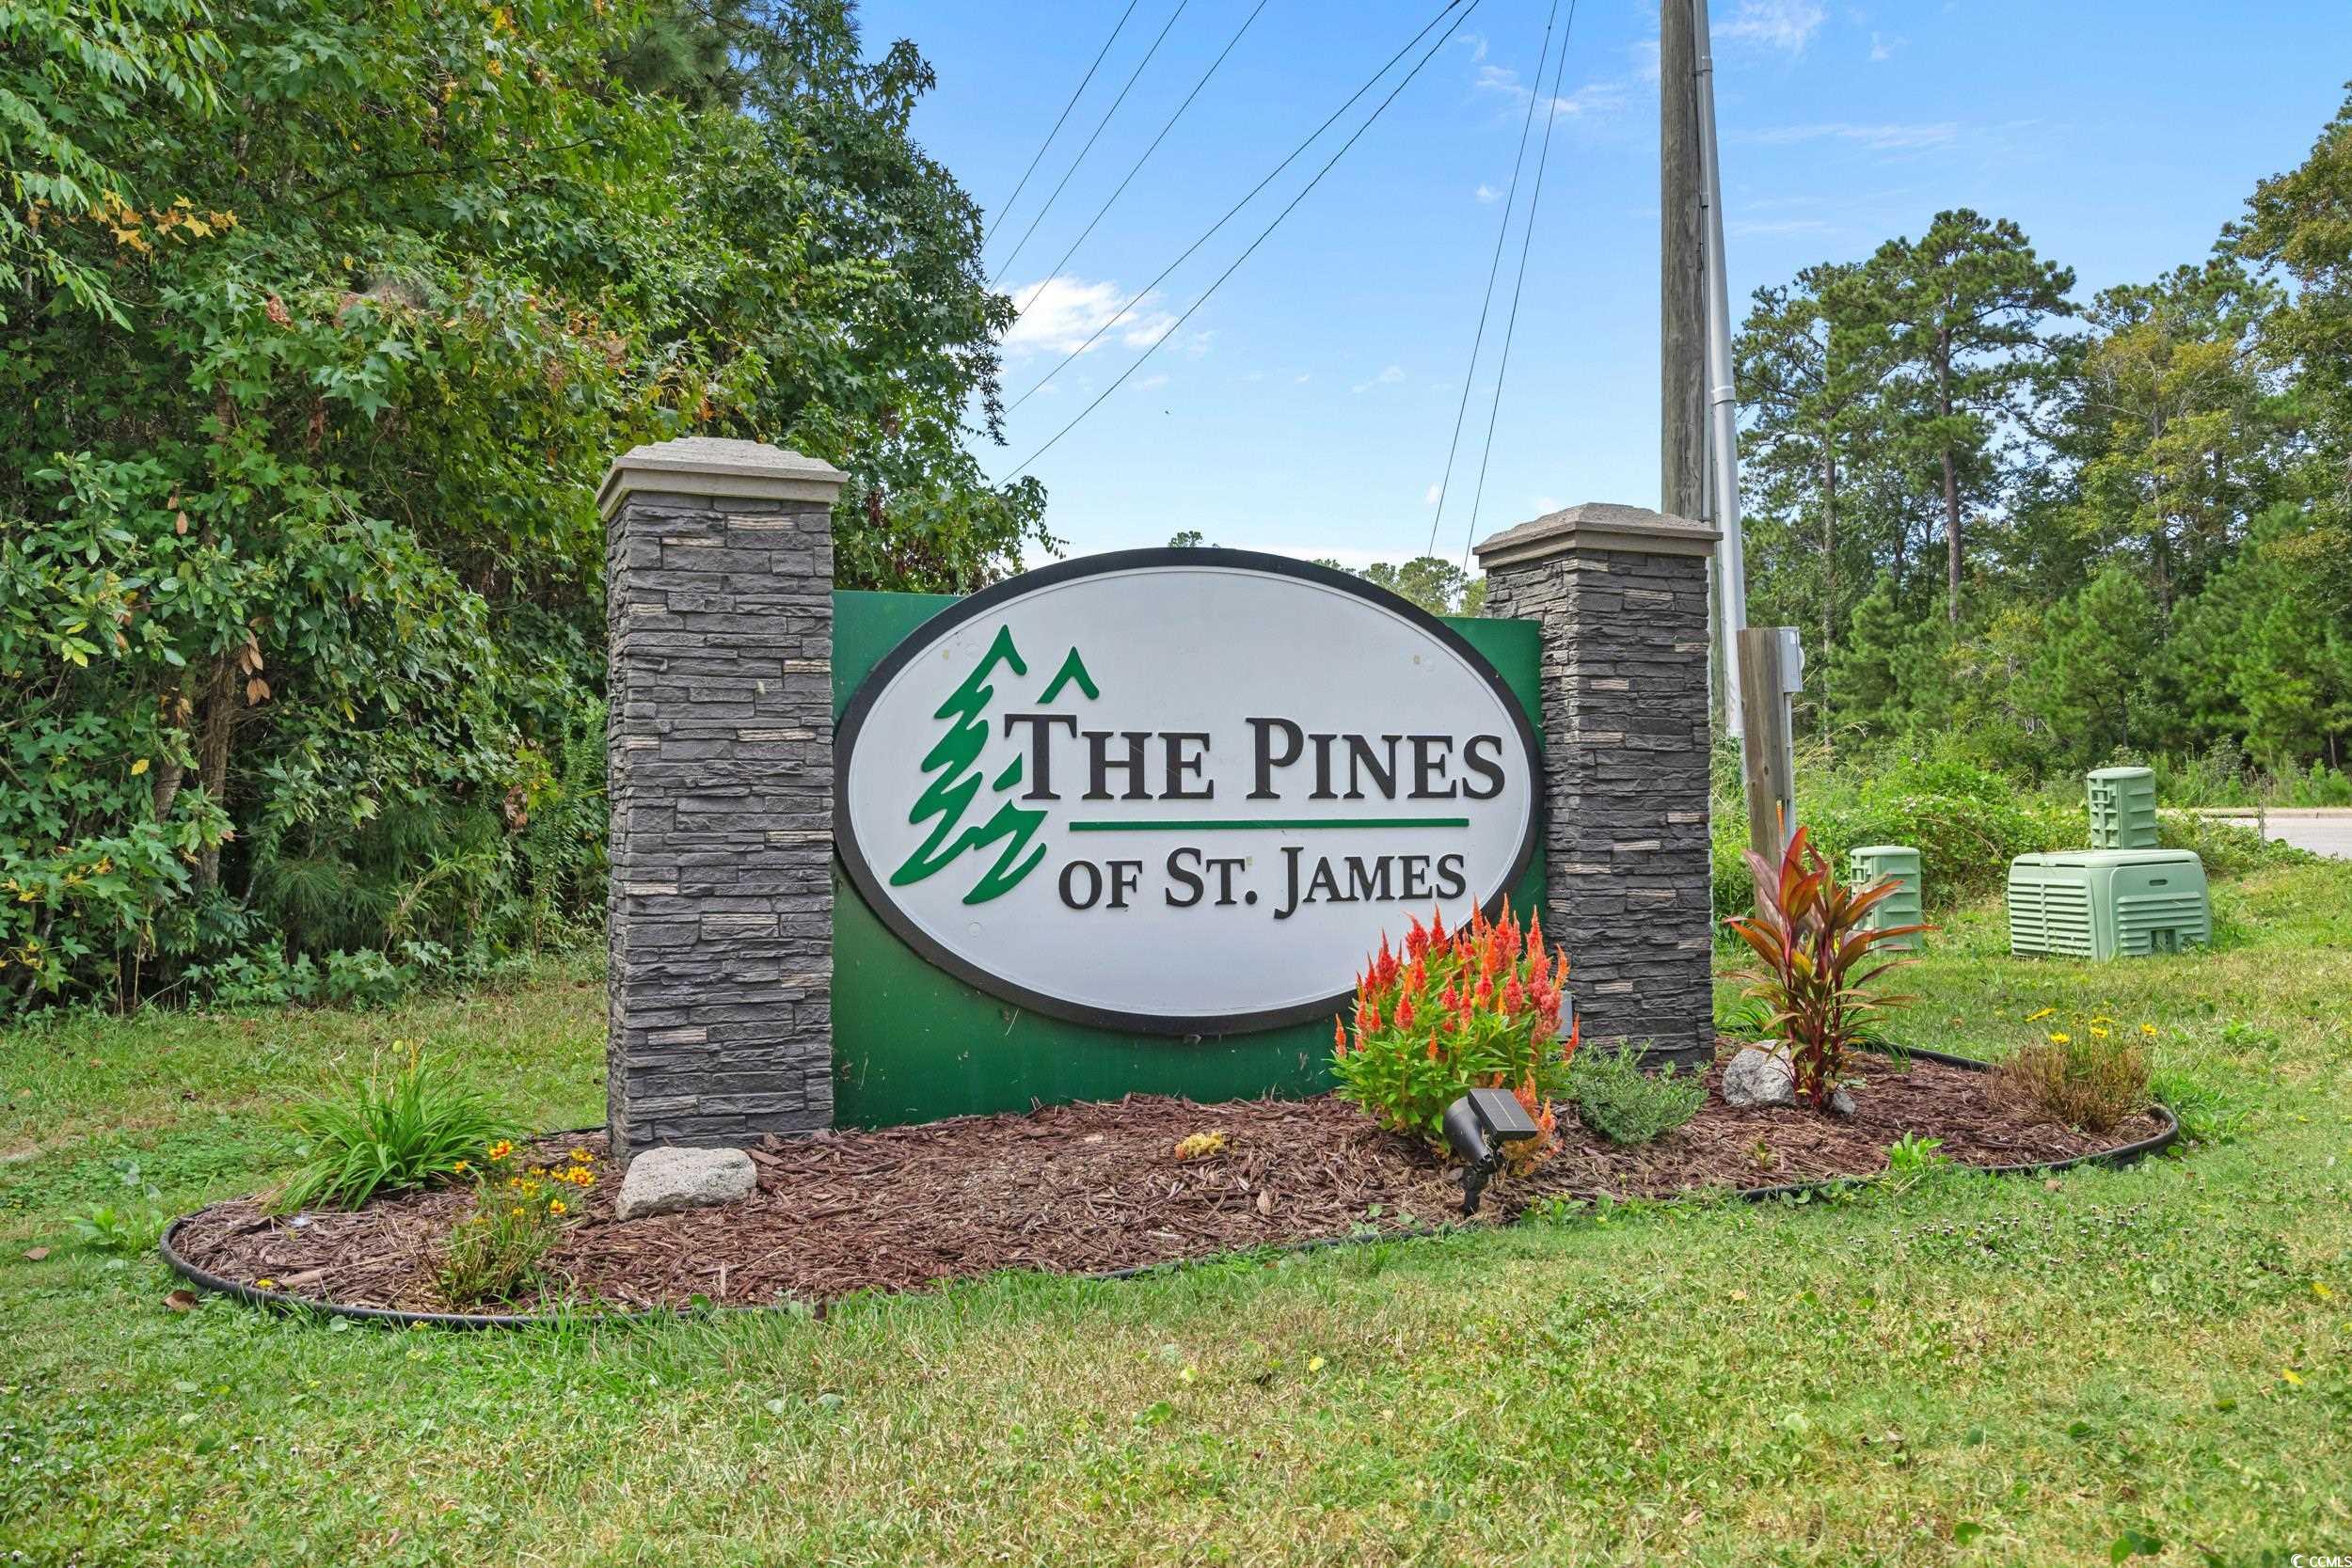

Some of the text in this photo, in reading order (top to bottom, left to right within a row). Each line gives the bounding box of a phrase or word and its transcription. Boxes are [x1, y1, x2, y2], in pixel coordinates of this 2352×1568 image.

[1004, 713, 1506, 800] THE PINES
[1058, 847, 1468, 920] OF ST. JAMES
